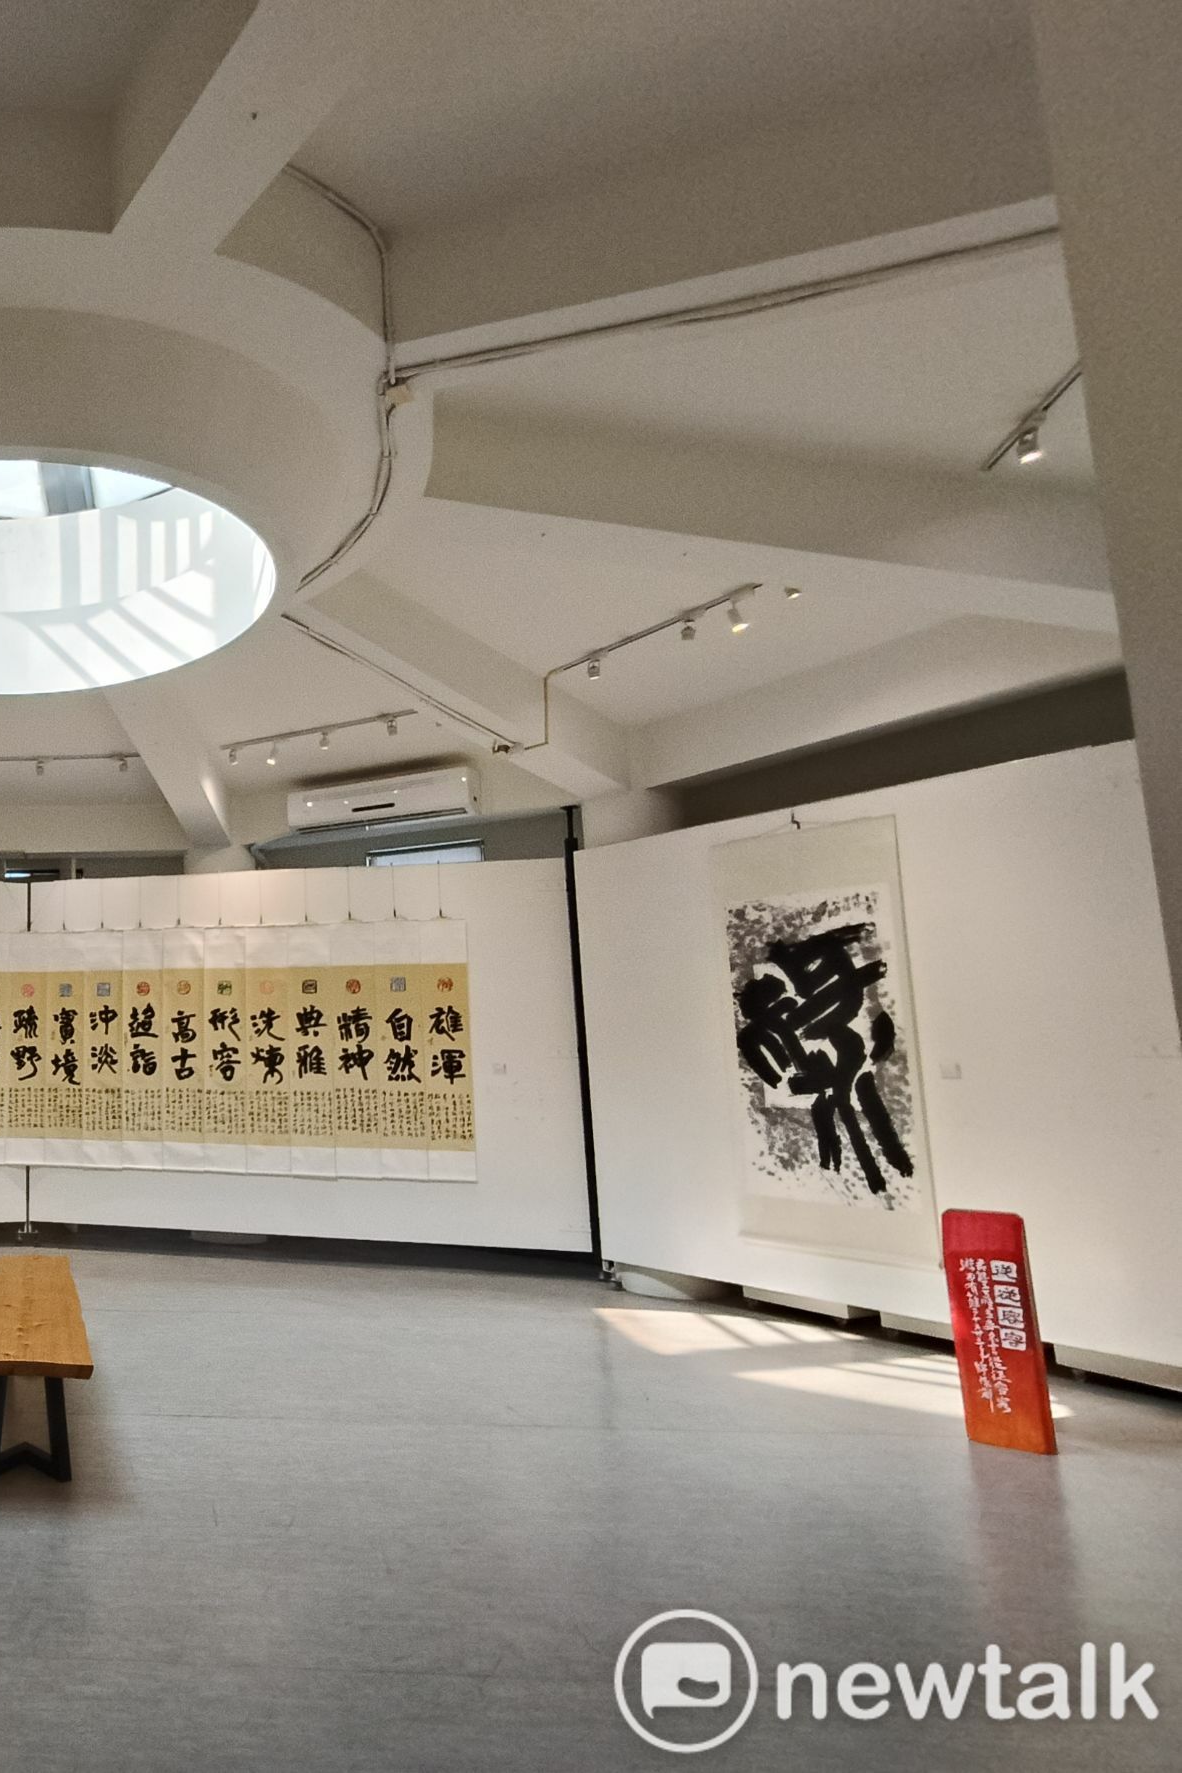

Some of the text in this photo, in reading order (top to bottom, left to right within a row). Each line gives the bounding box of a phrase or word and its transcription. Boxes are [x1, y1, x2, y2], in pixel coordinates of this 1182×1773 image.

[170, 1010, 197, 1081] 高古
[208, 1007, 242, 1082] 形容
[295, 1004, 327, 1079] 典雅
[336, 1005, 375, 1081] 精神
[383, 1007, 422, 1084] 自然
[428, 1005, 466, 1085] 雄渾
